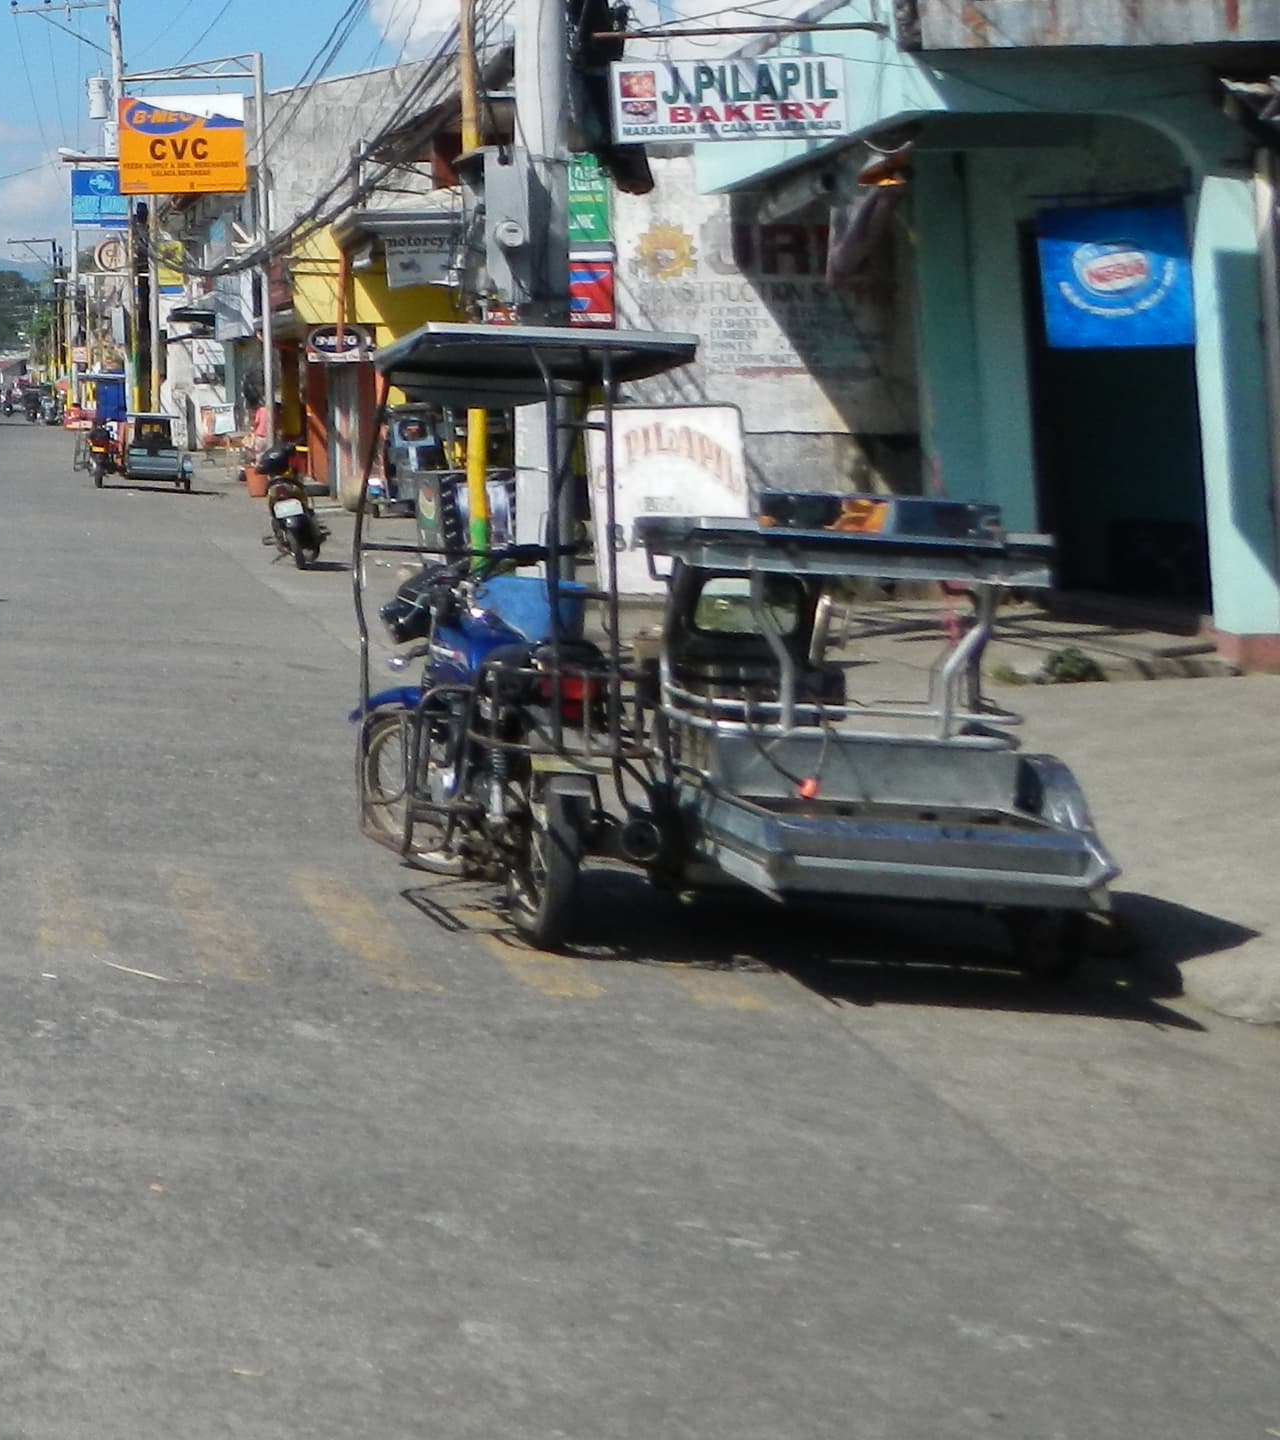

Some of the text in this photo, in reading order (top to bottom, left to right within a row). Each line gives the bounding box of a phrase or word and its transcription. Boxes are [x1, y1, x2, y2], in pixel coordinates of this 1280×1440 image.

[668, 101, 832, 124] BAKERY
[621, 124, 696, 137] MARASIGAN
[721, 122, 772, 134] CALACA
[149, 137, 209, 161] CVC
